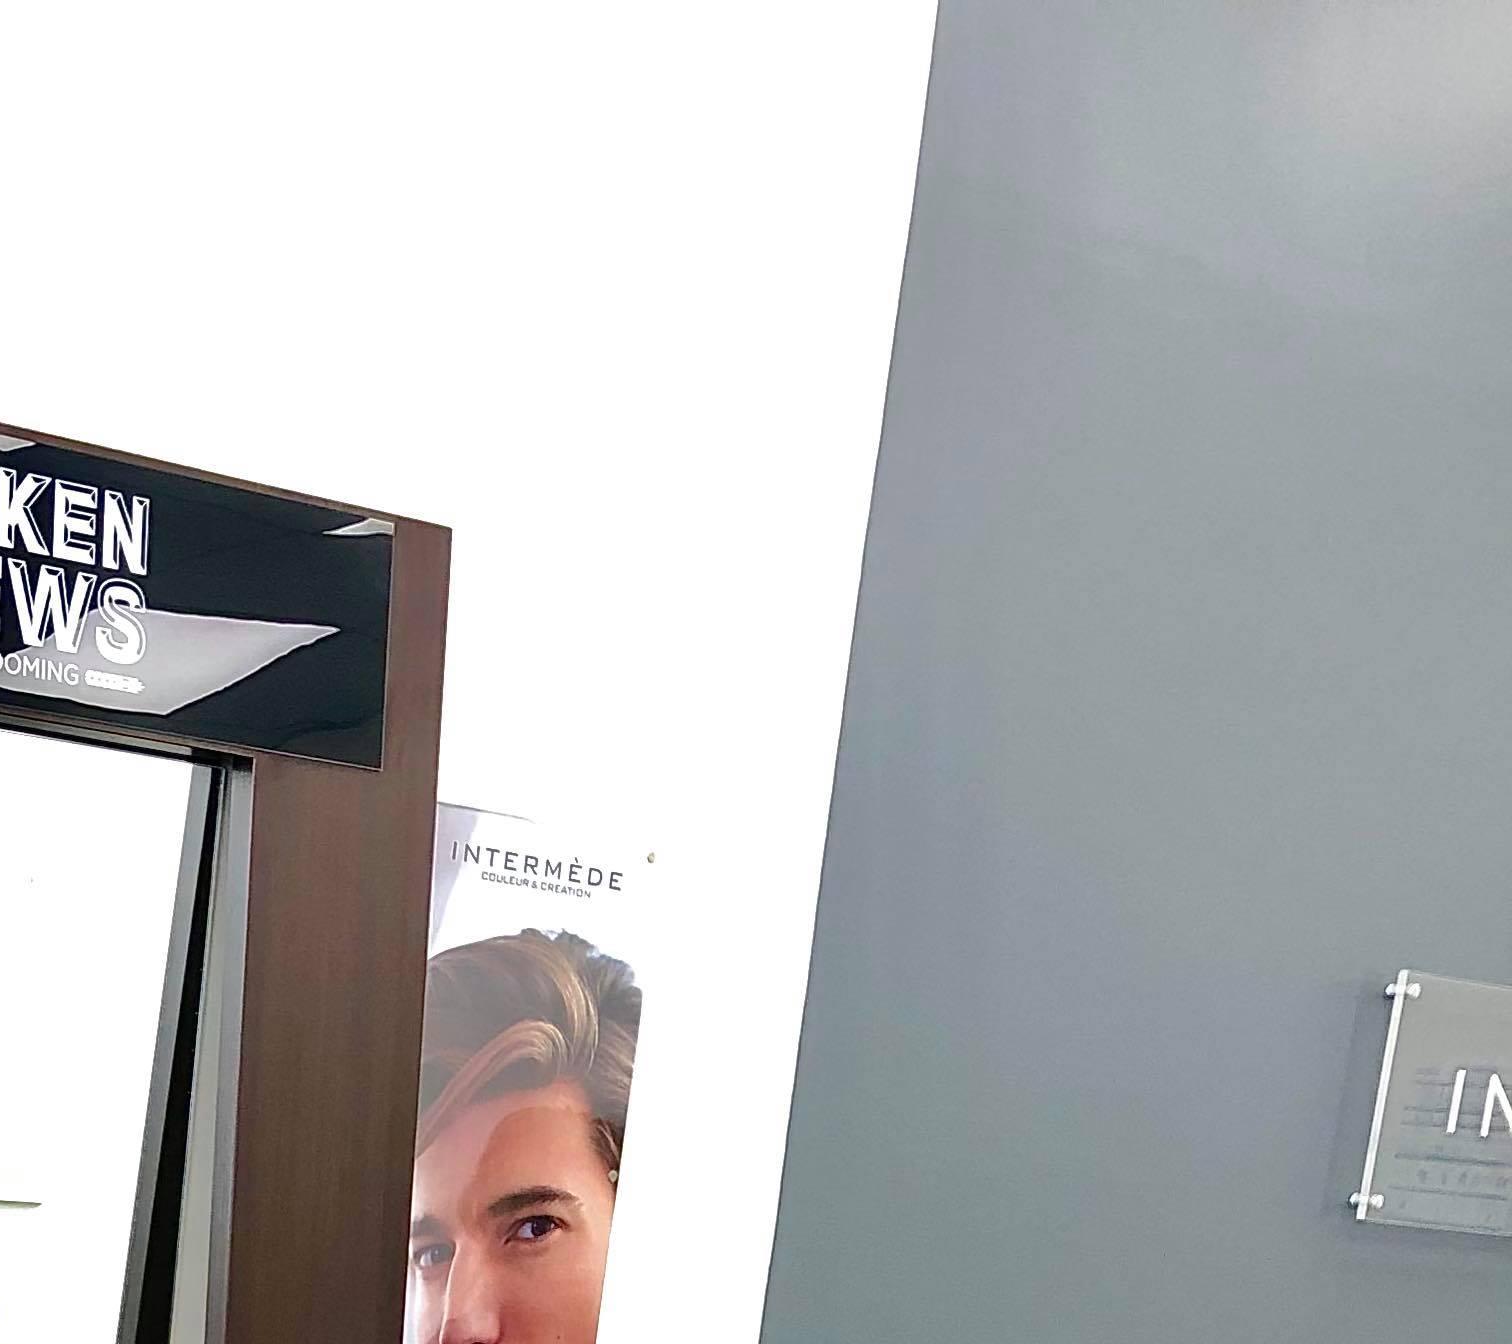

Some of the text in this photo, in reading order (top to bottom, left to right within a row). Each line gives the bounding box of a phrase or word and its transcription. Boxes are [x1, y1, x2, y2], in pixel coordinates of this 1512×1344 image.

[451, 840, 624, 892] INTERMÈDE
[481, 870, 530, 888] COULEUR
[531, 881, 539, 890] &
